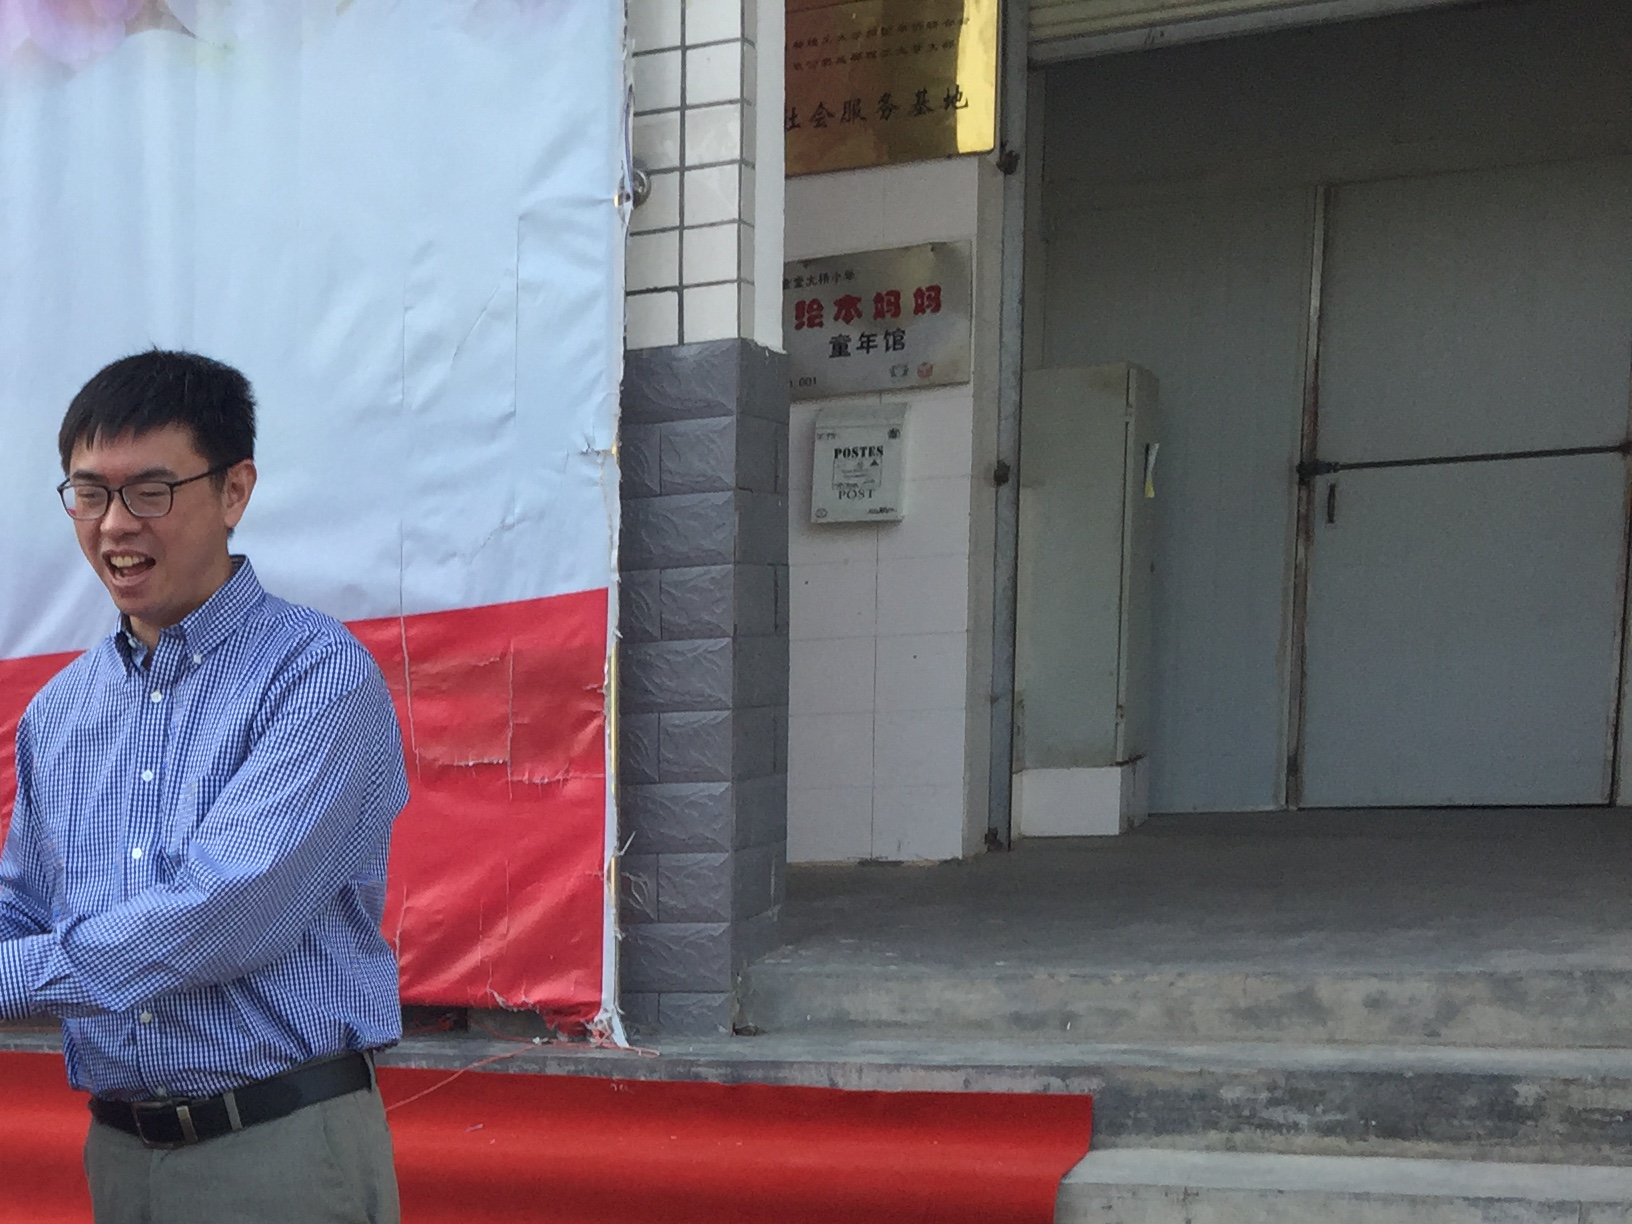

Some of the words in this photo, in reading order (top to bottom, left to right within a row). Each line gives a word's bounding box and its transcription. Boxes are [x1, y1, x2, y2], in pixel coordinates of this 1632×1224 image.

[794, 284, 942, 330] 绘本妈妈
[828, 327, 906, 359] 童年馆
[834, 445, 884, 459] POSTES
[838, 488, 874, 500] POST
